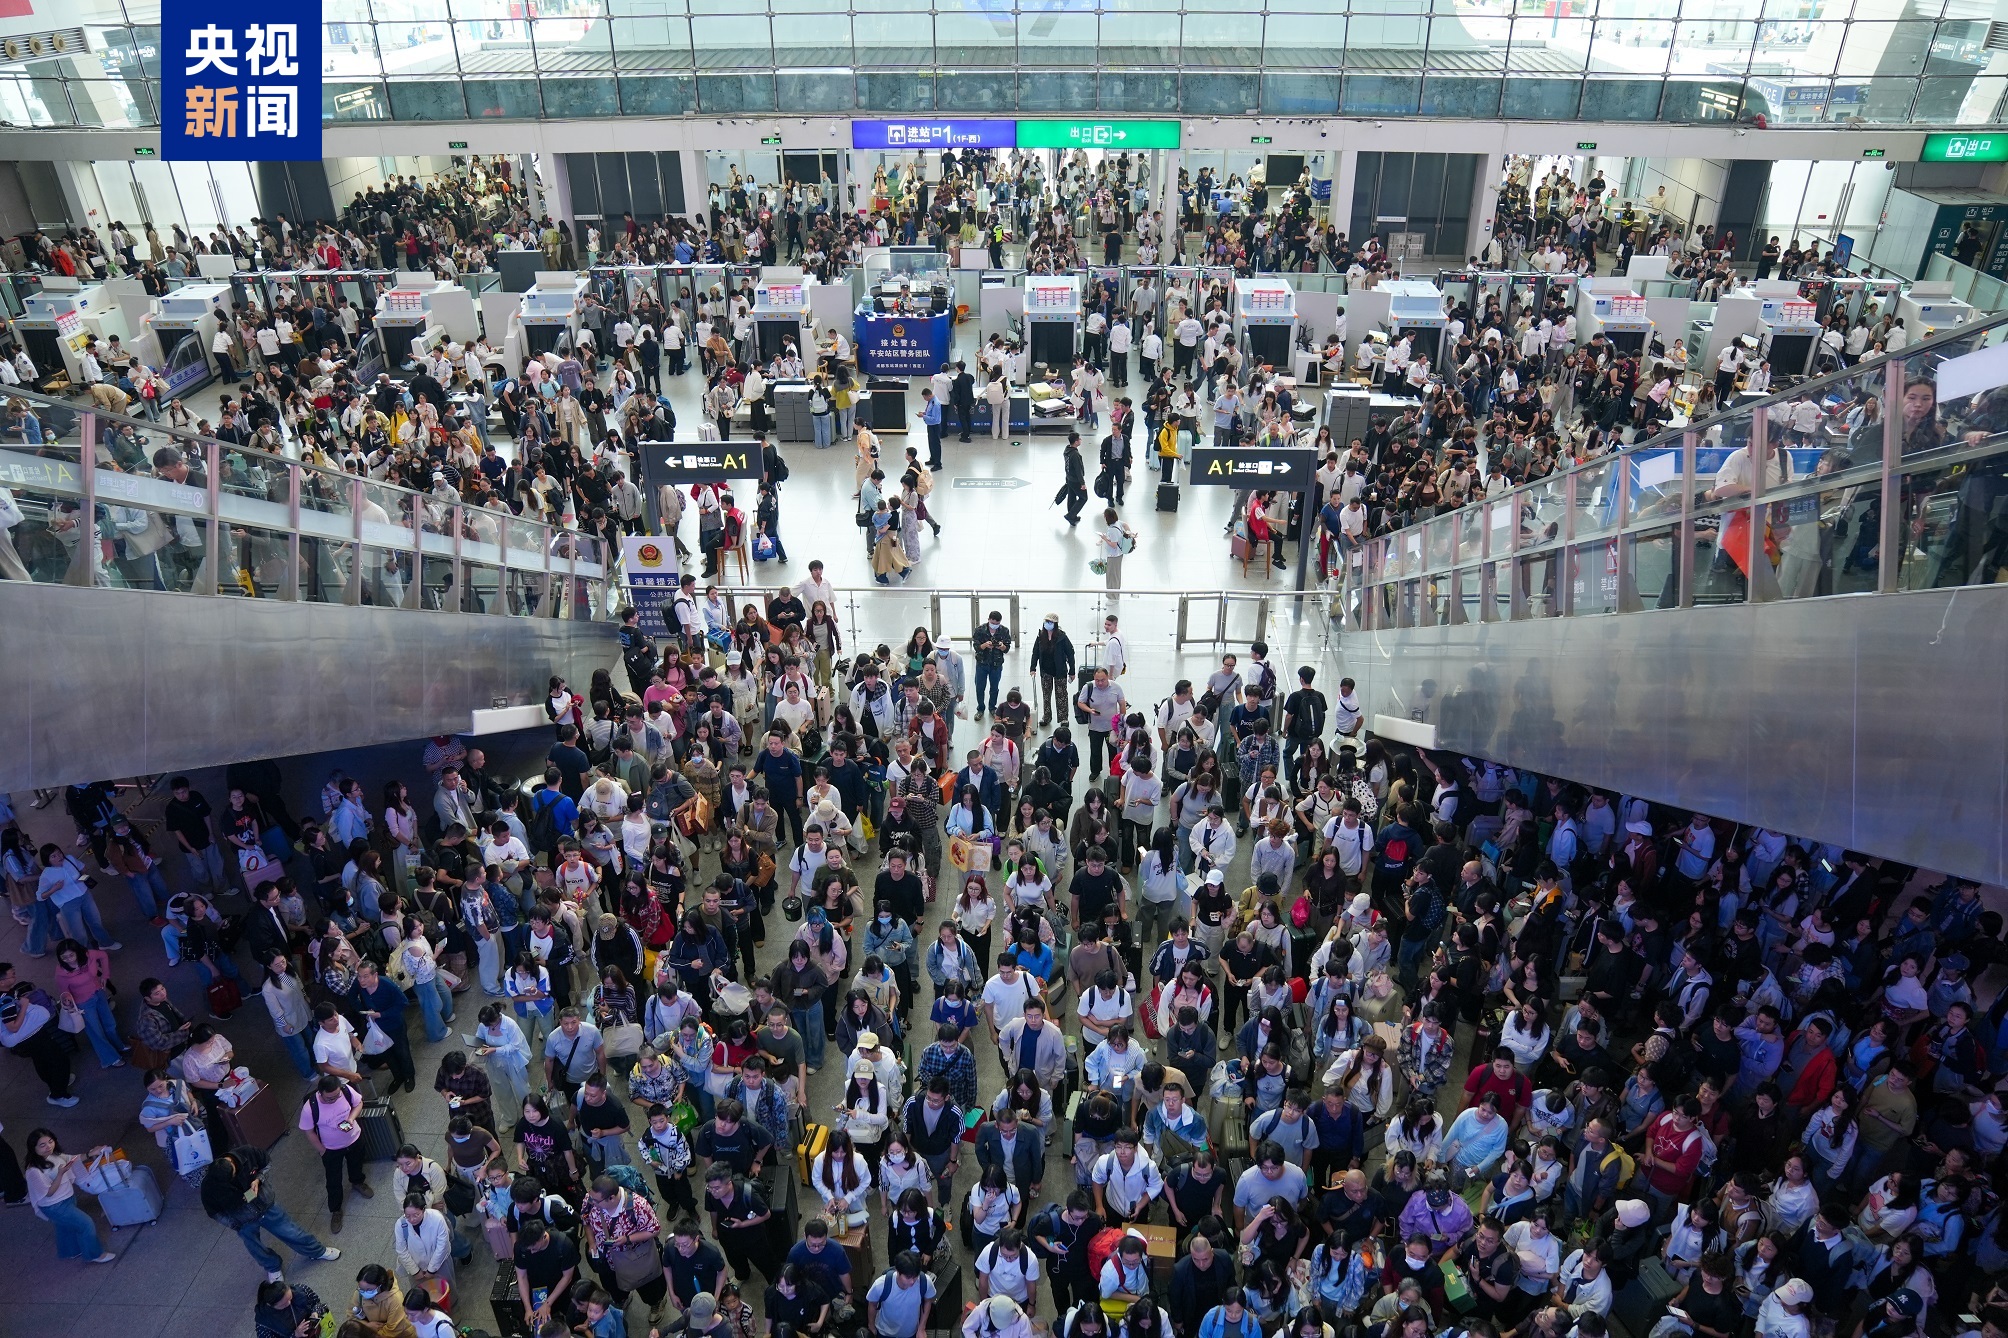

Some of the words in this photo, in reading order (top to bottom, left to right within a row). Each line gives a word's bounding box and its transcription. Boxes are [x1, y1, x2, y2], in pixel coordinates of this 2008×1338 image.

[1070, 126, 1091, 138] 出口
[1967, 139, 1991, 150] 出口
[880, 339, 918, 347] 接处警台
[869, 349, 931, 358] 平安站区警务团队
[723, 453, 747, 470] A1
[1207, 459, 1233, 475] A1
[634, 577, 677, 586] 温馨提示
